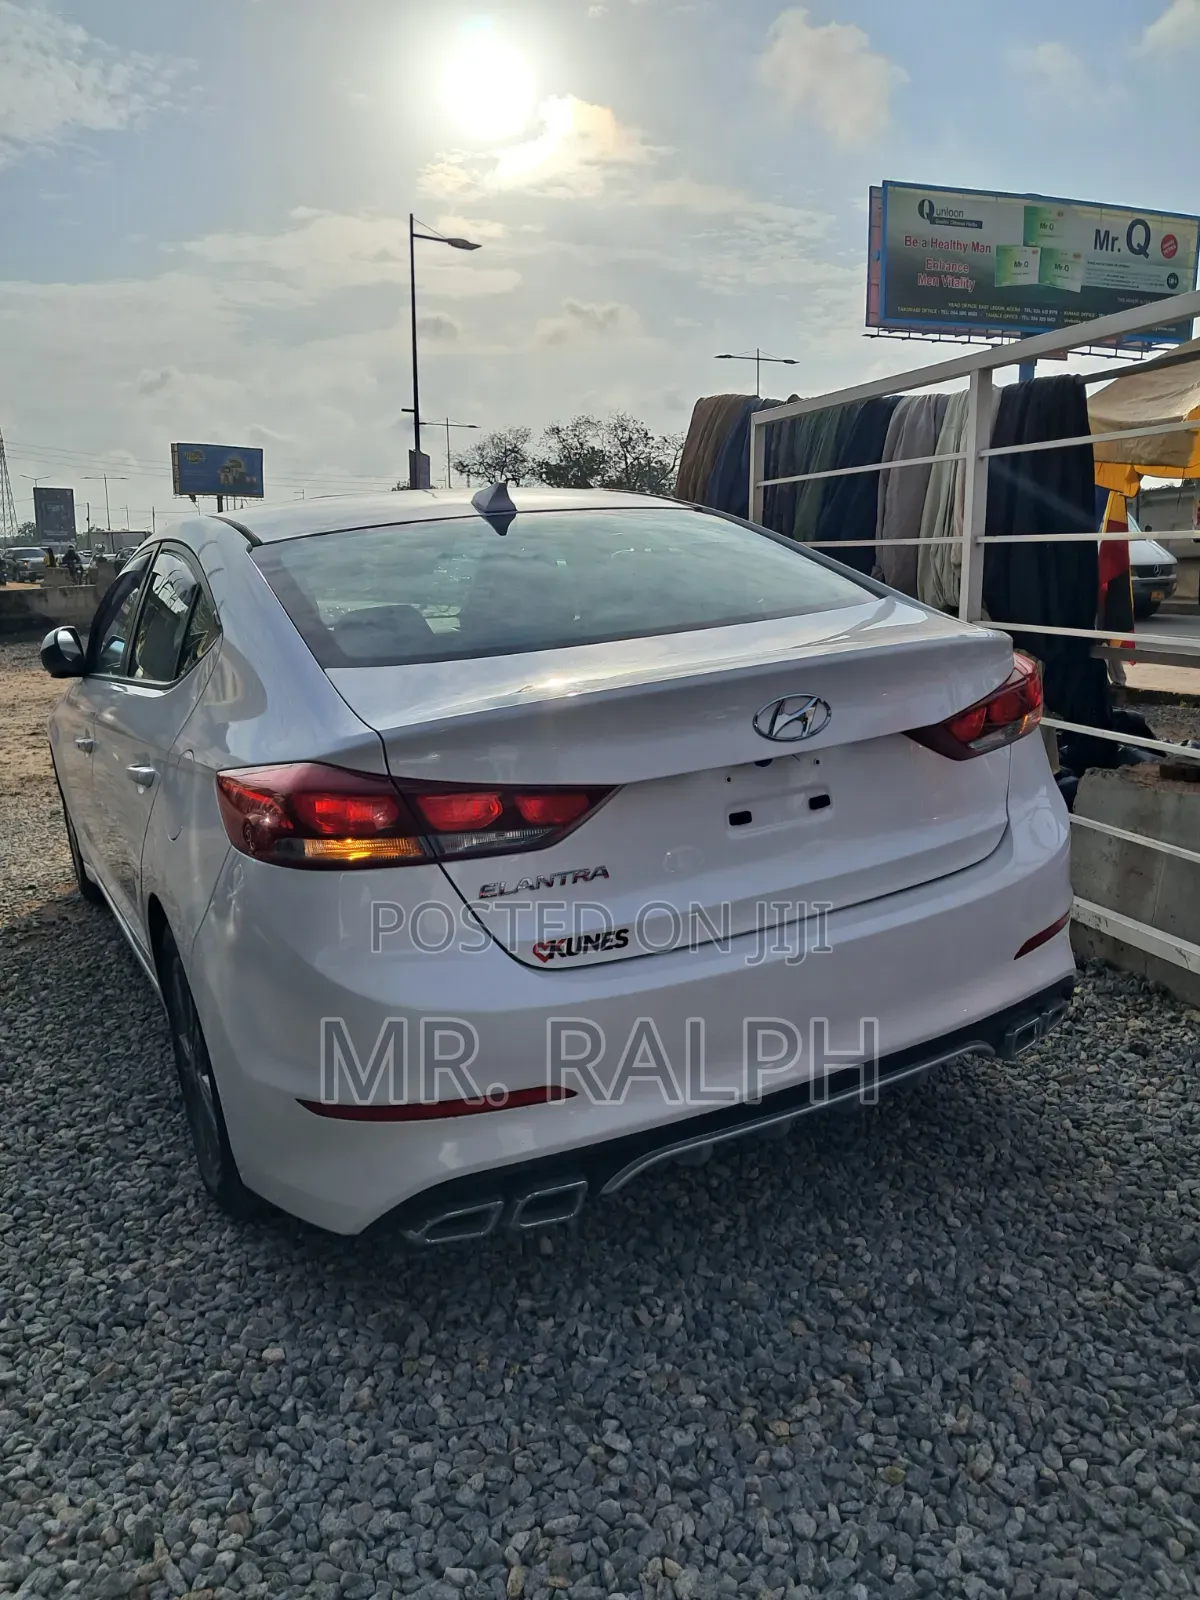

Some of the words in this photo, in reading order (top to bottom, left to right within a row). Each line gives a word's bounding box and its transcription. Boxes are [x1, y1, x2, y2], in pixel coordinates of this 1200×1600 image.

[904, 235, 918, 248] Be
[921, 239, 927, 248] a
[930, 237, 968, 254] Healthy
[971, 241, 991, 254] Man
[1094, 228, 1121, 253] Mr.
[1126, 218, 1151, 259] Q
[925, 257, 969, 274] Enhance
[918, 273, 940, 287] Men
[941, 274, 976, 293] Vitality
[479, 865, 610, 899] ELANTRA
